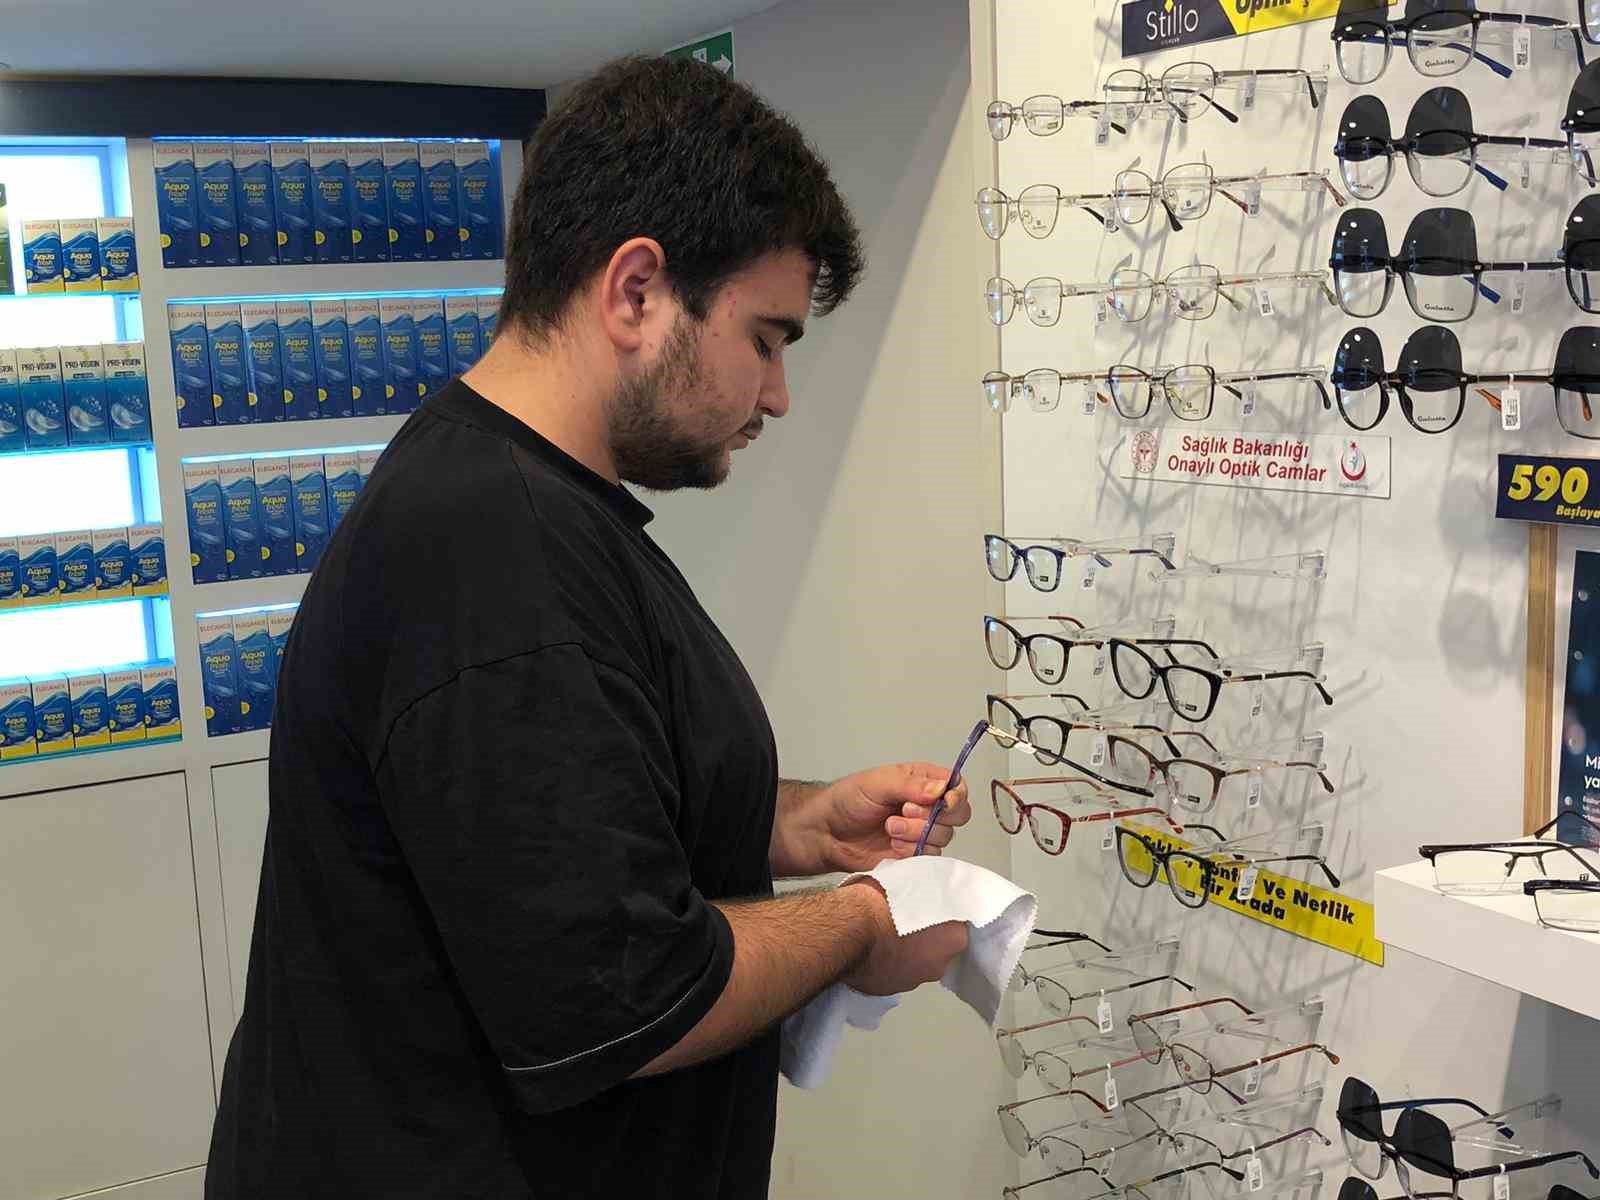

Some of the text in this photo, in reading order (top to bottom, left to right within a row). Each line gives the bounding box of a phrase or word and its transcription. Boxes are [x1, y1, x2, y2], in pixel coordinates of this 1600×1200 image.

[1146, 4, 1199, 40] Stillo
[1182, 436, 1227, 455] Sağlık
[1232, 438, 1309, 462] Bakanlığı
[1168, 456, 1327, 482] Onaylı Optik Camlar
[1507, 464, 1589, 504] 590
[262, 496, 287, 506] Aqua
[1262, 878, 1286, 900] Ve
[1292, 890, 1356, 924] Netlik
